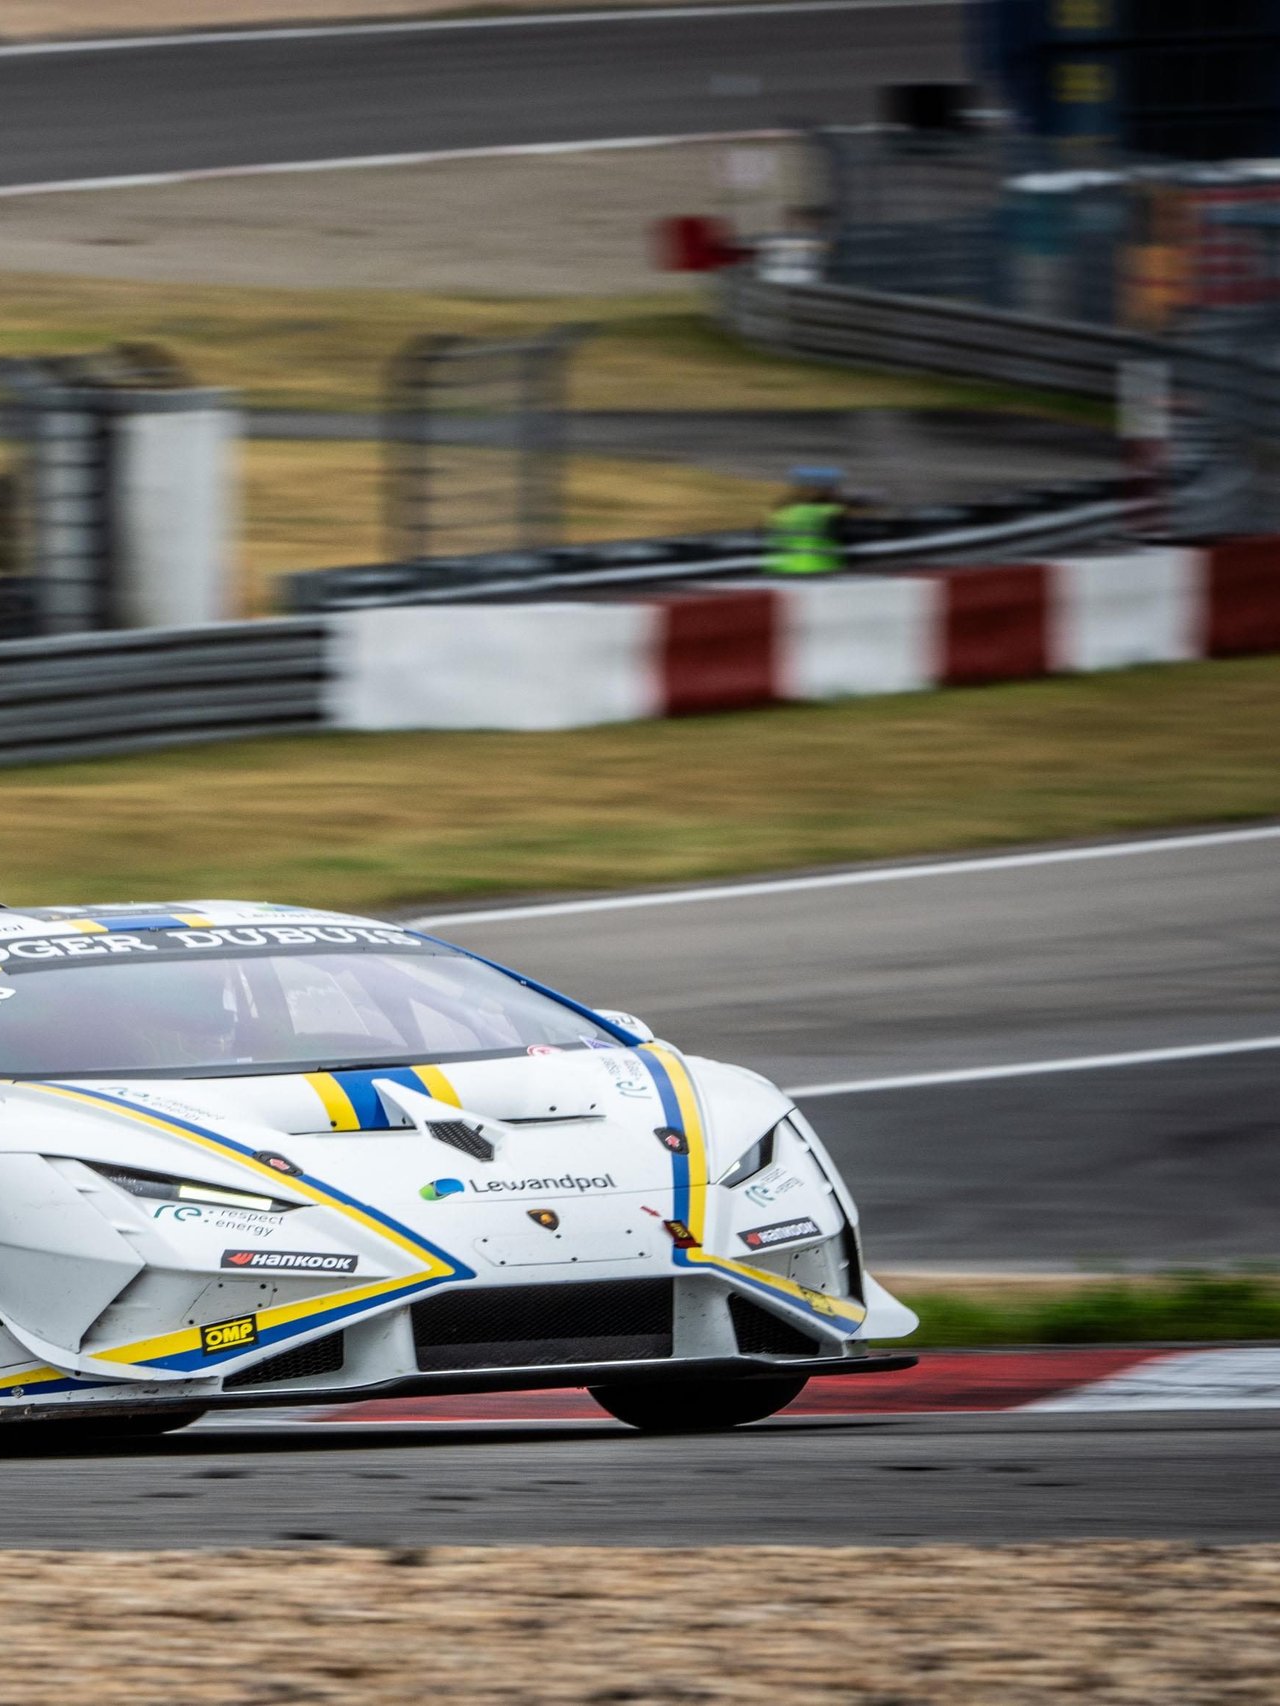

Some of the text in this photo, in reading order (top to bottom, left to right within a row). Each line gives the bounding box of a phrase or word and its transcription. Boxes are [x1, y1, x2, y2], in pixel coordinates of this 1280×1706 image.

[166, 926, 422, 949] DUBUIS
[469, 1173, 618, 1193] Lewandpol
[221, 1209, 285, 1226] respect
[215, 1219, 274, 1238] energy
[205, 1322, 254, 1346] OMP
